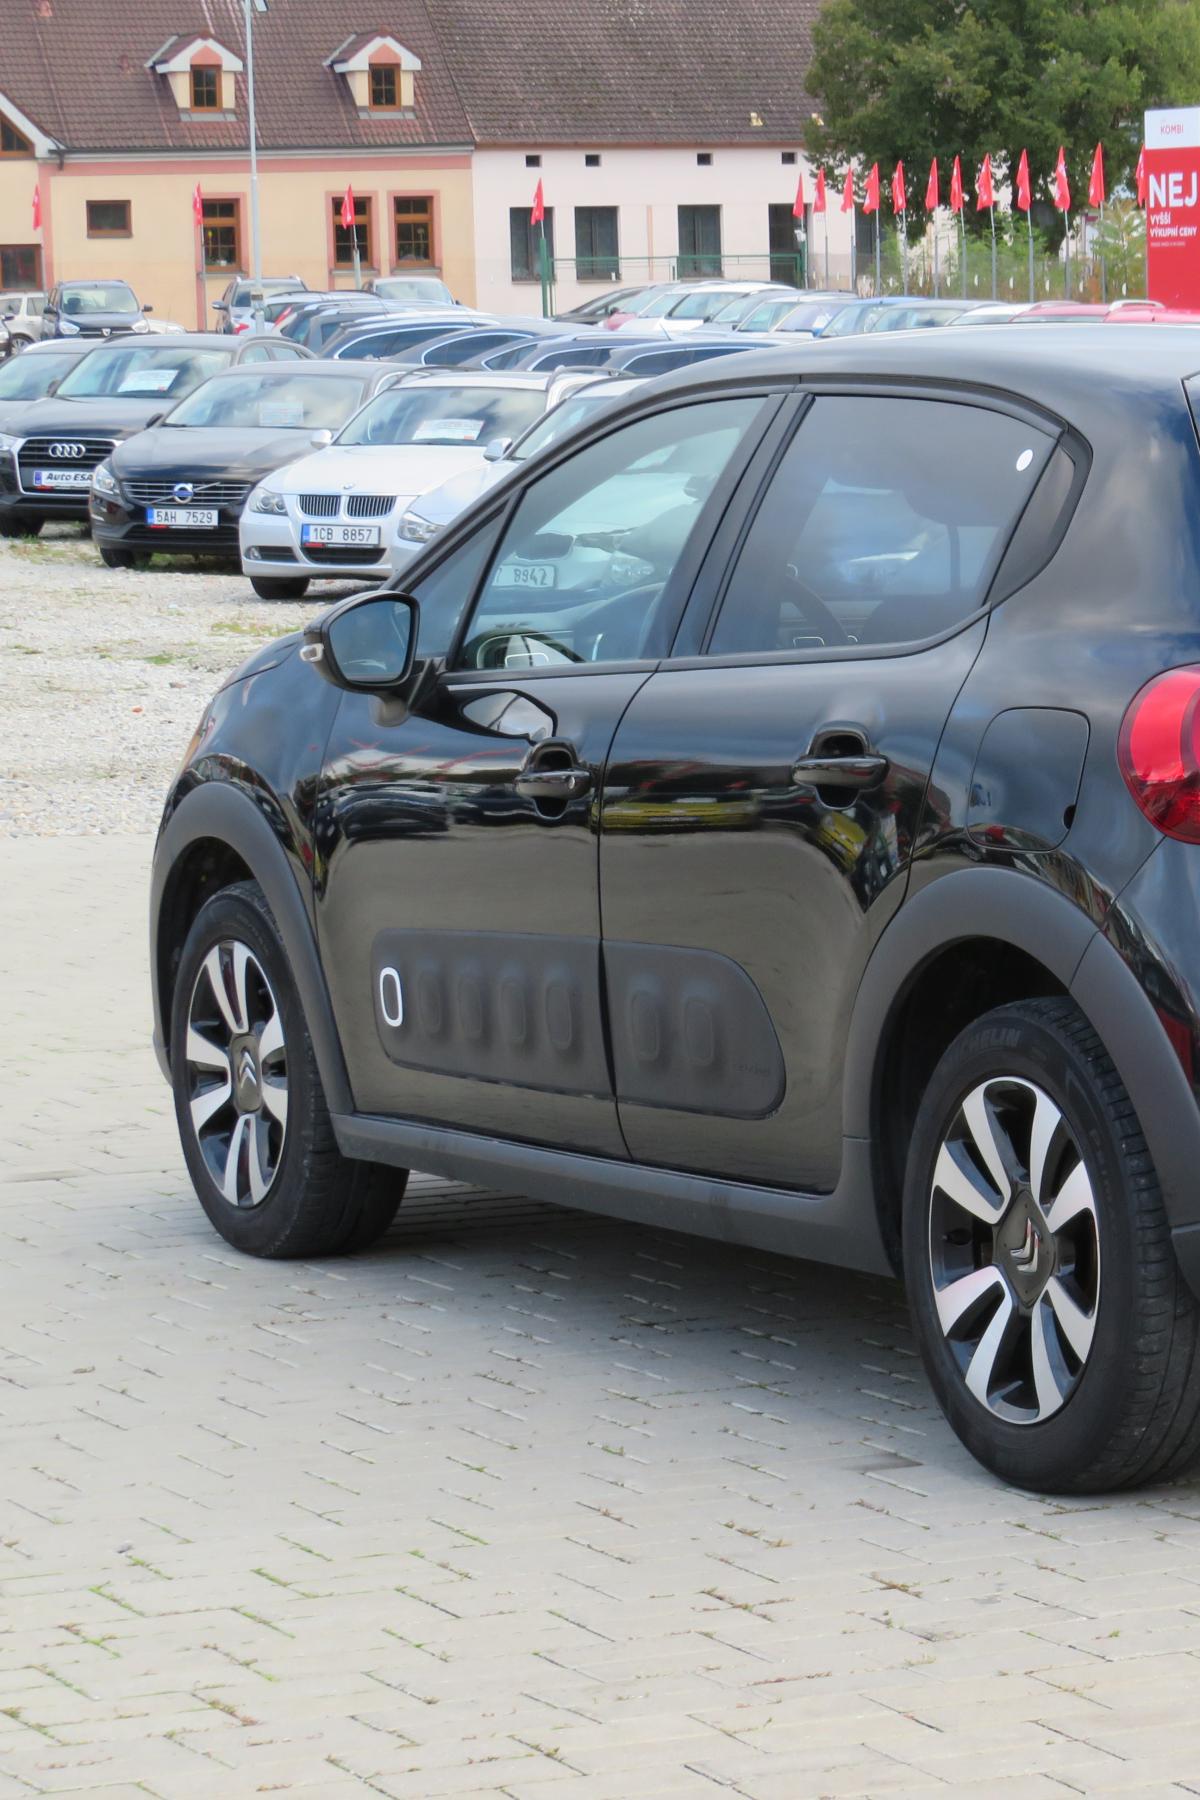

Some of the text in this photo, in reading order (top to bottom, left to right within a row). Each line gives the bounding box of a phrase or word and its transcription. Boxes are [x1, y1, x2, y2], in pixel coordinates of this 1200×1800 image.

[1160, 124, 1184, 136] KOMBI
[1149, 171, 1198, 208] NEJ
[1179, 226, 1197, 236] CENY
[46, 472, 93, 481] Auto ESA
[156, 511, 213, 523] 5AH 7529
[313, 528, 372, 541] 1CB 8857
